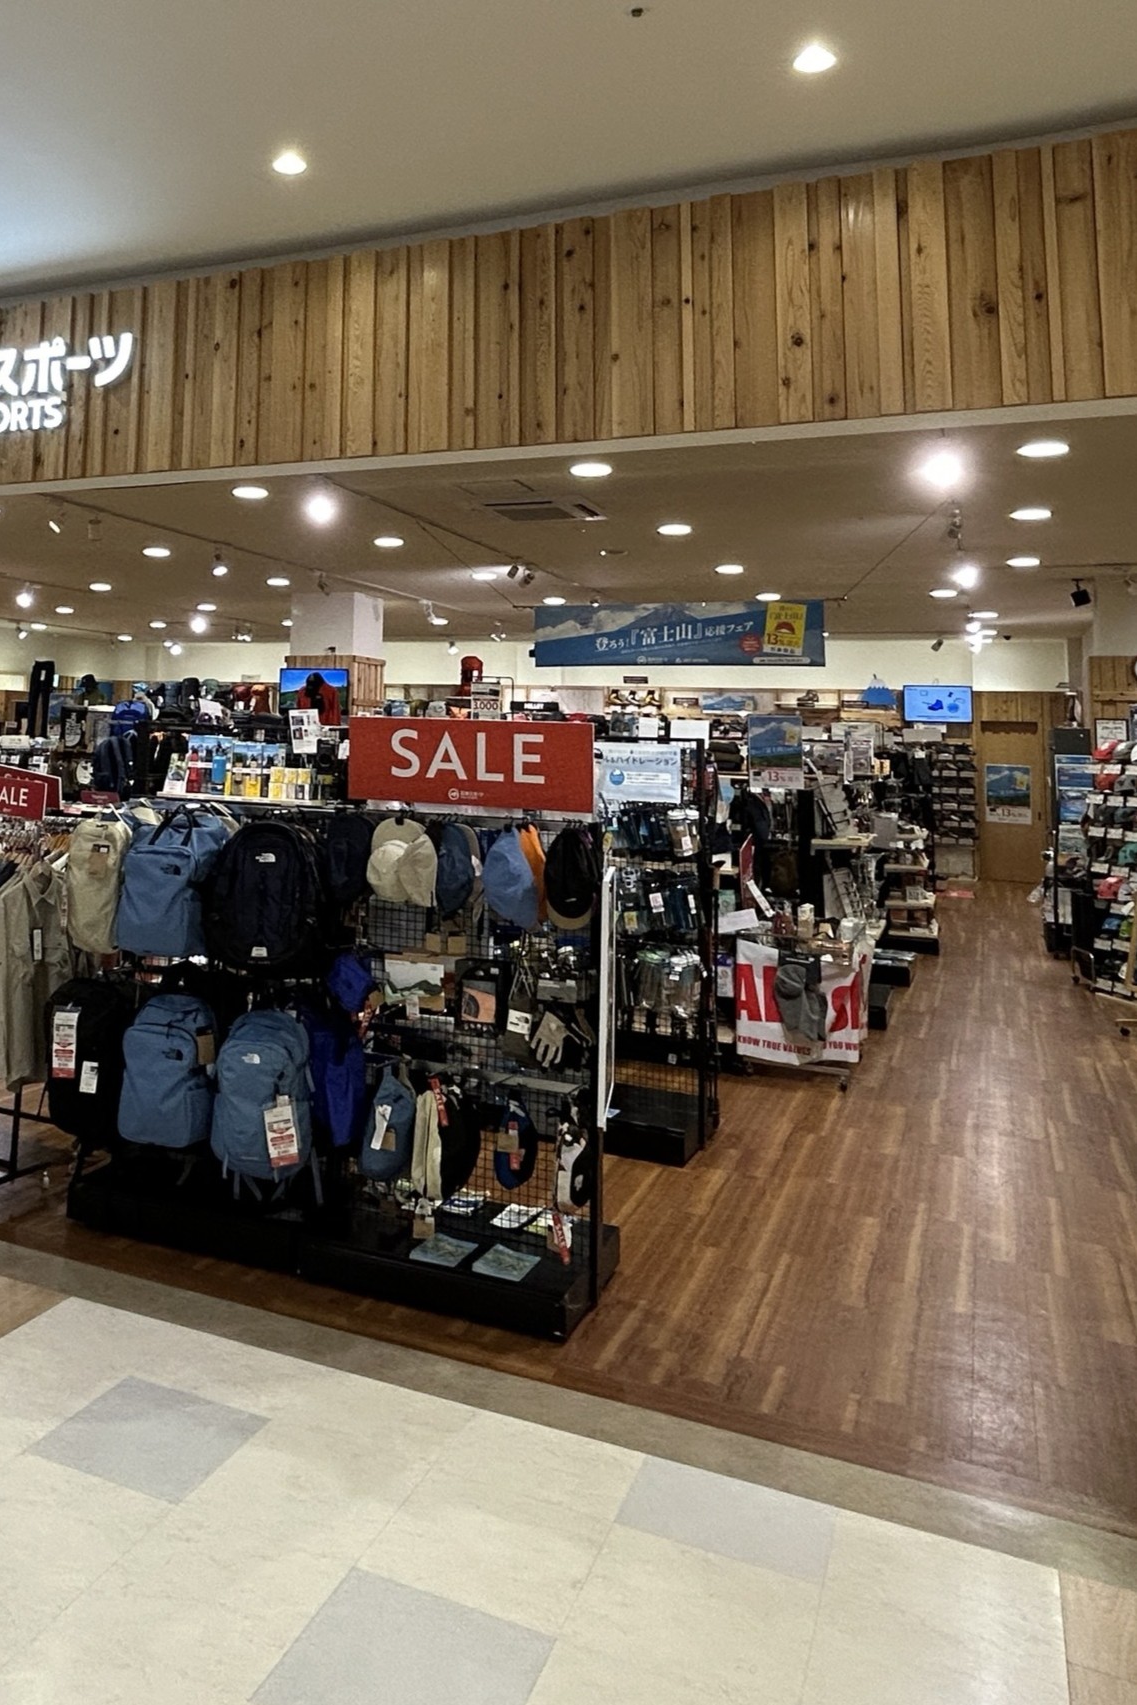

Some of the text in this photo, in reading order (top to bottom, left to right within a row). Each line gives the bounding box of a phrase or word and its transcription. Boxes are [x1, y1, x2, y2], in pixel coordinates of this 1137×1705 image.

[390, 728, 545, 784] SALE
[737, 1035, 760, 1047] KNOW
[762, 1039, 781, 1052] TRUE
